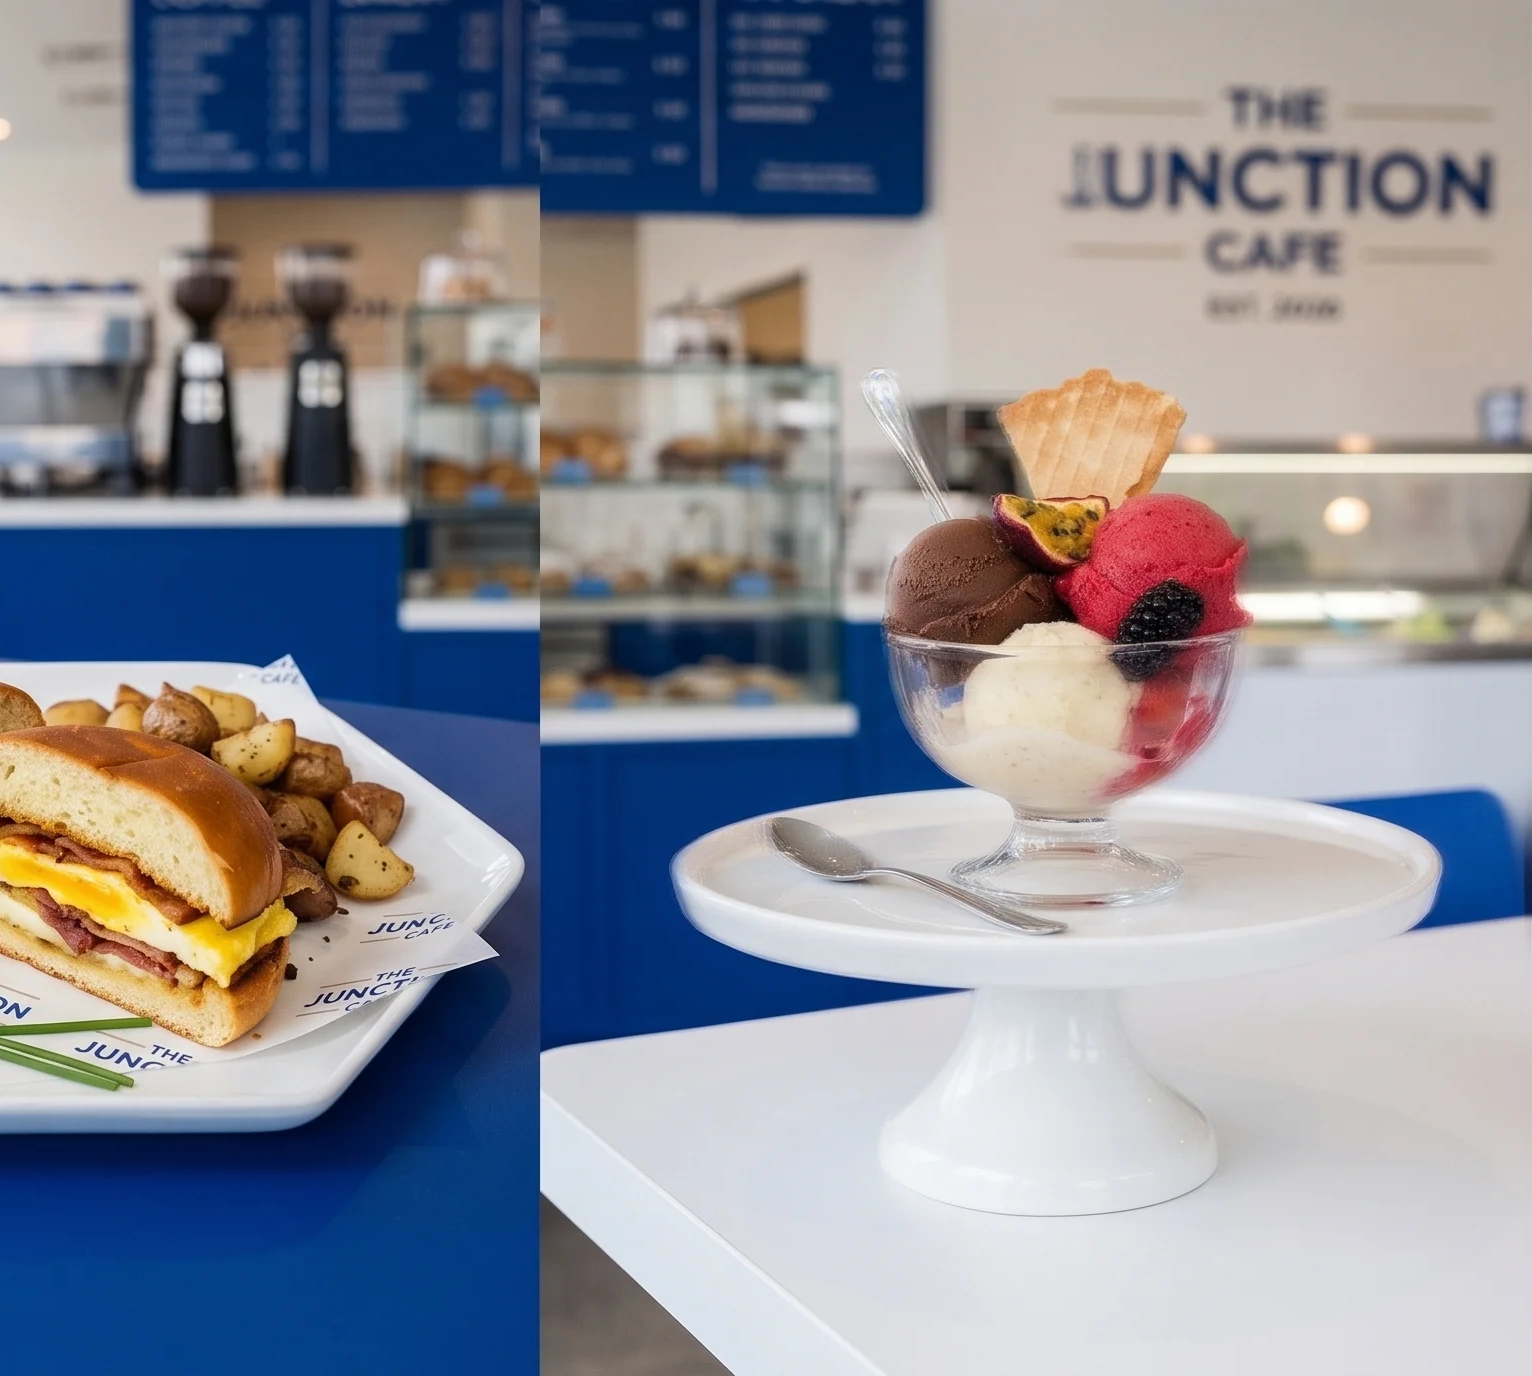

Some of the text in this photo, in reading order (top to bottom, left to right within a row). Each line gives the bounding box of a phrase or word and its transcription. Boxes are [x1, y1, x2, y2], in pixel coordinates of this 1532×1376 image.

[1227, 87, 1326, 130] THE
[1064, 146, 1496, 218] JUNCTION
[1205, 232, 1343, 275] CAFE
[367, 913, 451, 935] JUNC
[404, 920, 455, 940] CAFE
[376, 966, 416, 982] THE
[151, 1044, 194, 1065] THE
